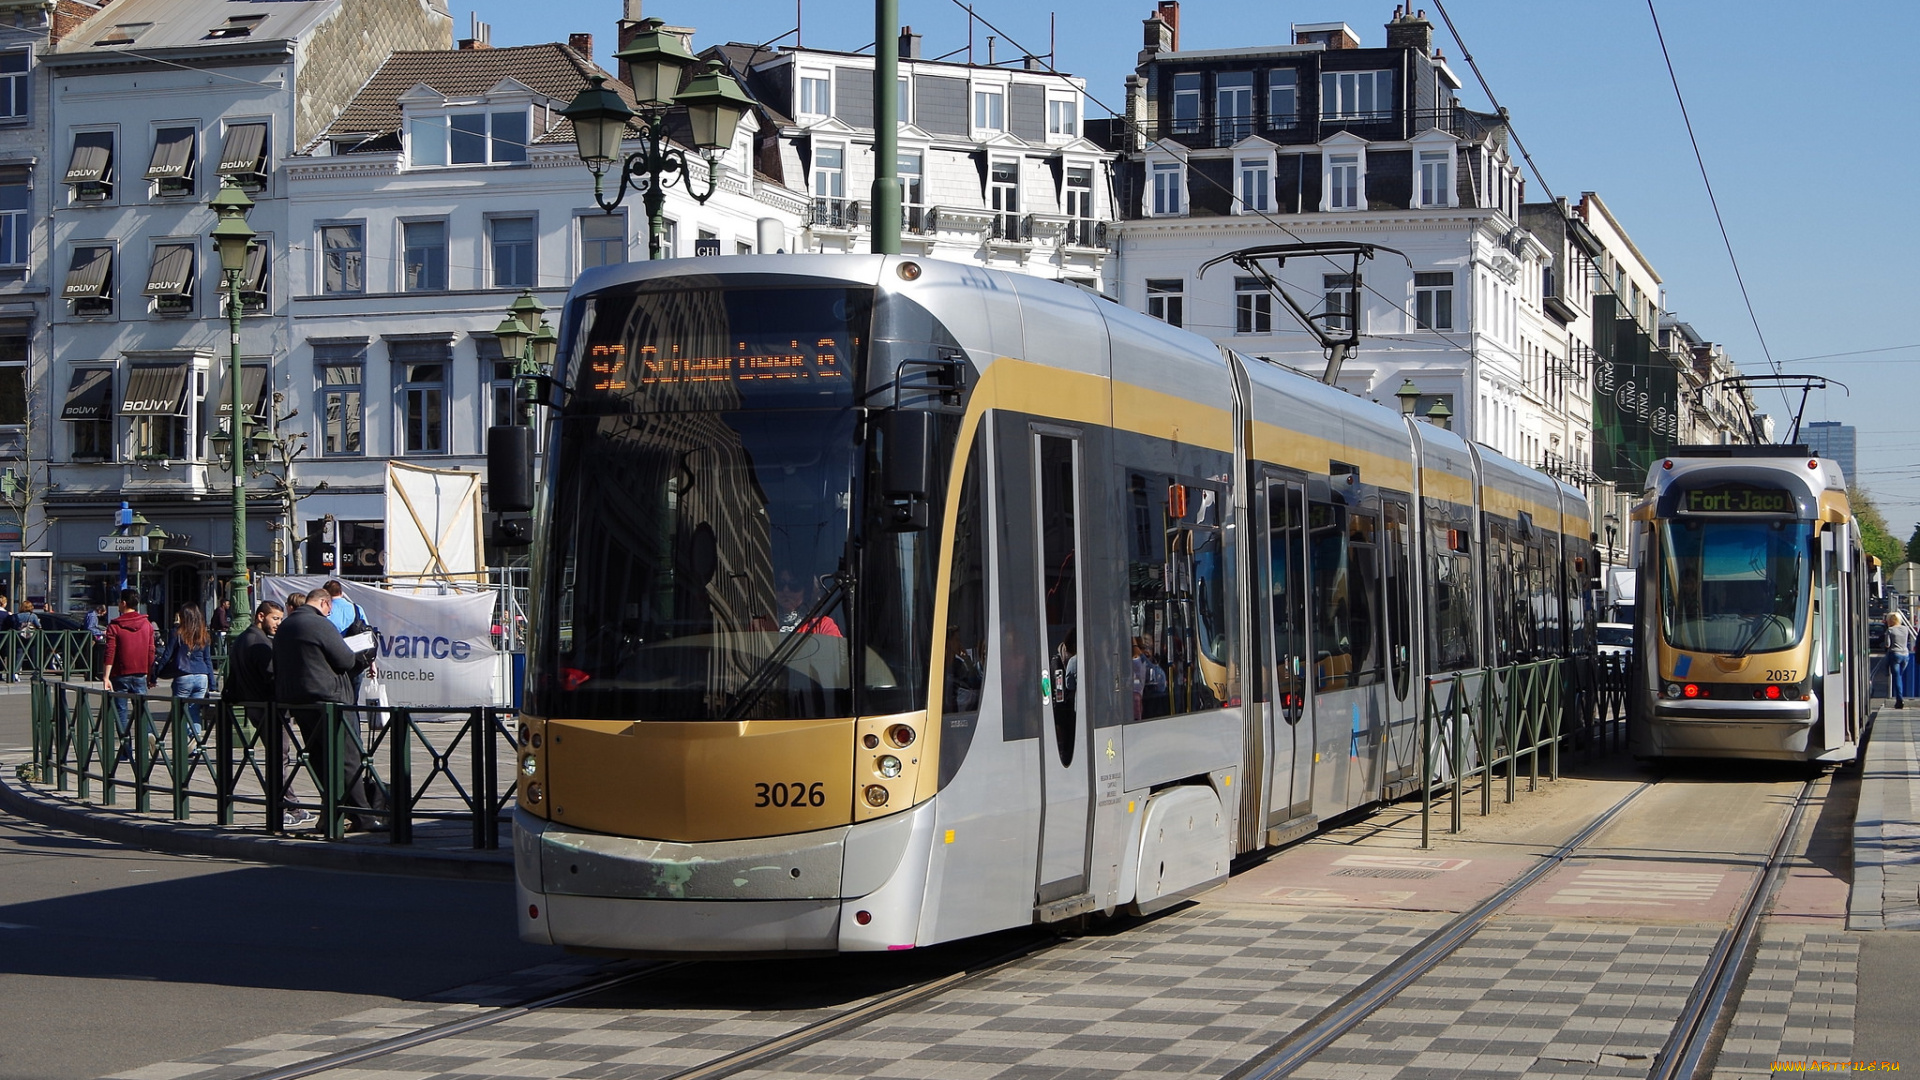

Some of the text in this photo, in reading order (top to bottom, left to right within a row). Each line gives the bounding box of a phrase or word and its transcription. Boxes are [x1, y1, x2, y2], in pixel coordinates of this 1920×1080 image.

[148, 164, 182, 174] BOUVY
[220, 160, 253, 169] BOUVY
[67, 169, 99, 177] BOUVY
[66, 284, 99, 293] BOUVY
[147, 281, 180, 291] BOUVY
[220, 278, 254, 287] BVY
[592, 344, 626, 390] 92
[1604, 361, 1615, 392] INNO
[1626, 380, 1636, 409] INNO
[66, 406, 98, 415] BOUVY
[122, 399, 173, 412] BOUVY
[220, 403, 253, 411] BOVY
[1639, 392, 1649, 419] INNO
[1657, 406, 1667, 432] INNO
[1668, 413, 1677, 439] INNO
[1690, 490, 1784, 510] Fort-Jaco
[376, 632, 471, 660] vance
[1765, 669, 1797, 682] 2037
[754, 782, 826, 808] 3026
